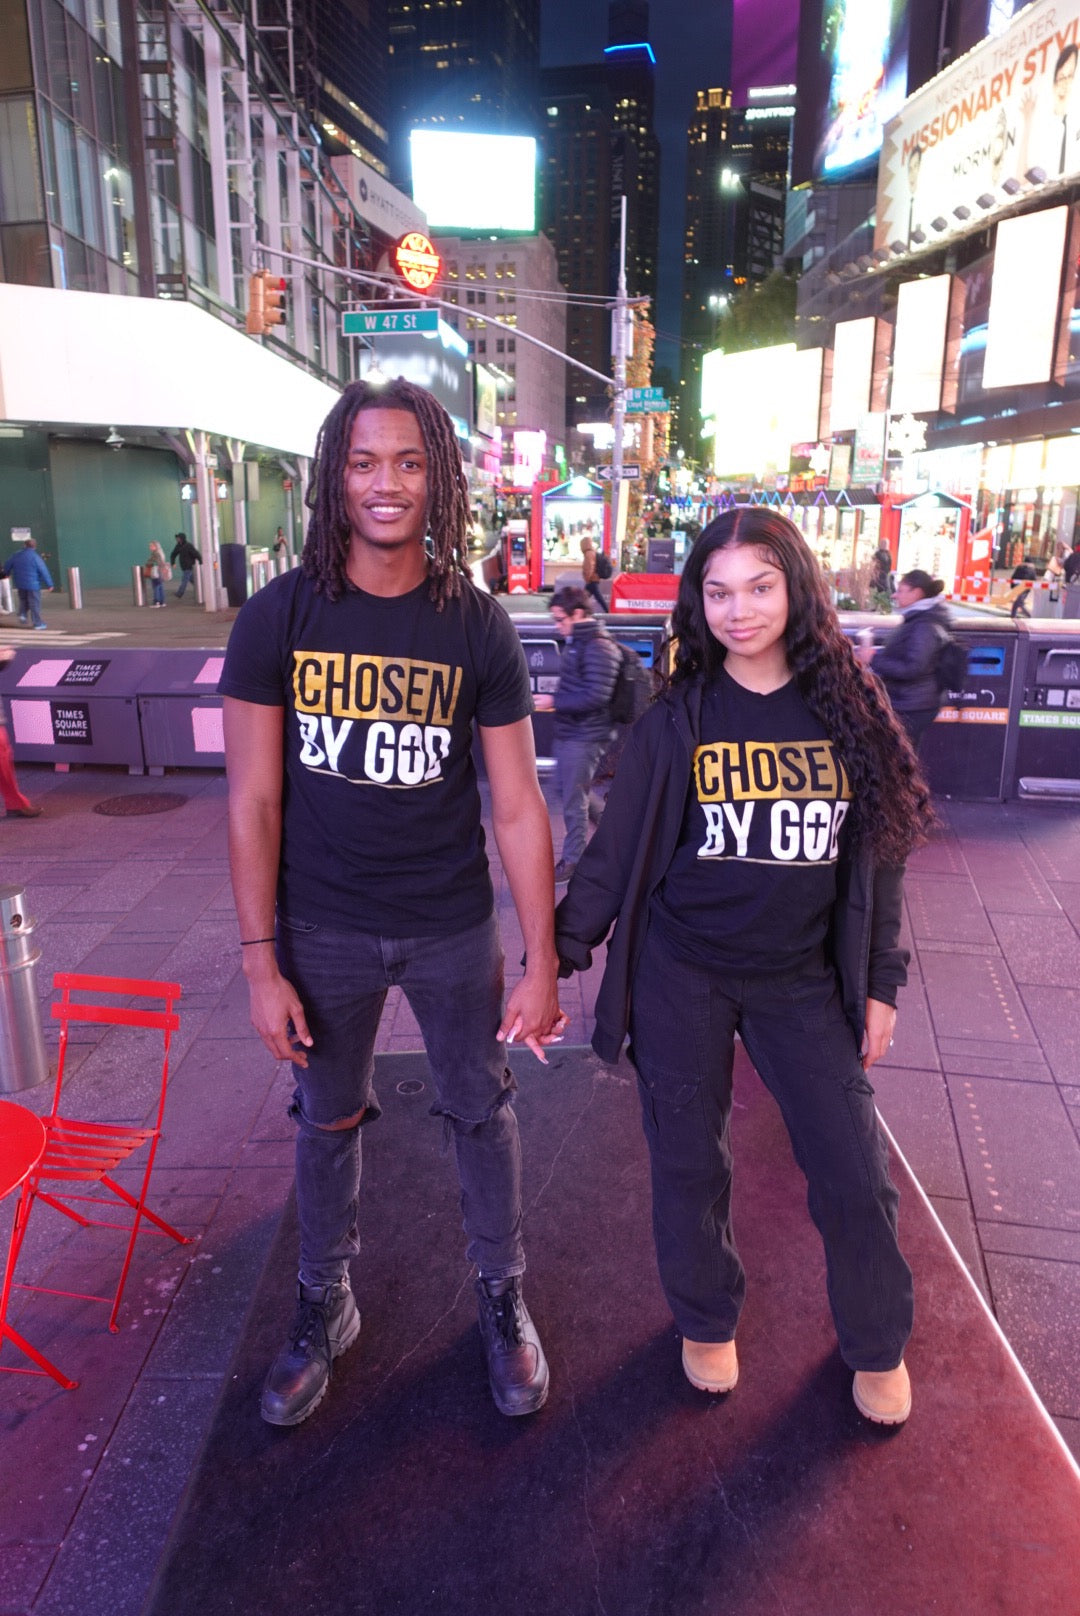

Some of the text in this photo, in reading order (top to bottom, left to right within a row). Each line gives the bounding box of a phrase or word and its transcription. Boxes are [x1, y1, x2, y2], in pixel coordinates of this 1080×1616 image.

[902, 60, 1019, 166] MISSIONARY
[364, 314, 417, 330] W 47 St
[644, 389, 653, 399] 47
[627, 600, 652, 608] TIMES
[66, 670, 101, 678] SQUARE
[297, 654, 458, 726] CHOSEN
[57, 710, 84, 719] TIMES
[961, 710, 1006, 721] SQUARE
[1022, 714, 1060, 724] TIMES
[55, 719, 88, 729] SQUARE
[296, 711, 451, 785] BY GOD
[697, 800, 755, 858] BY
